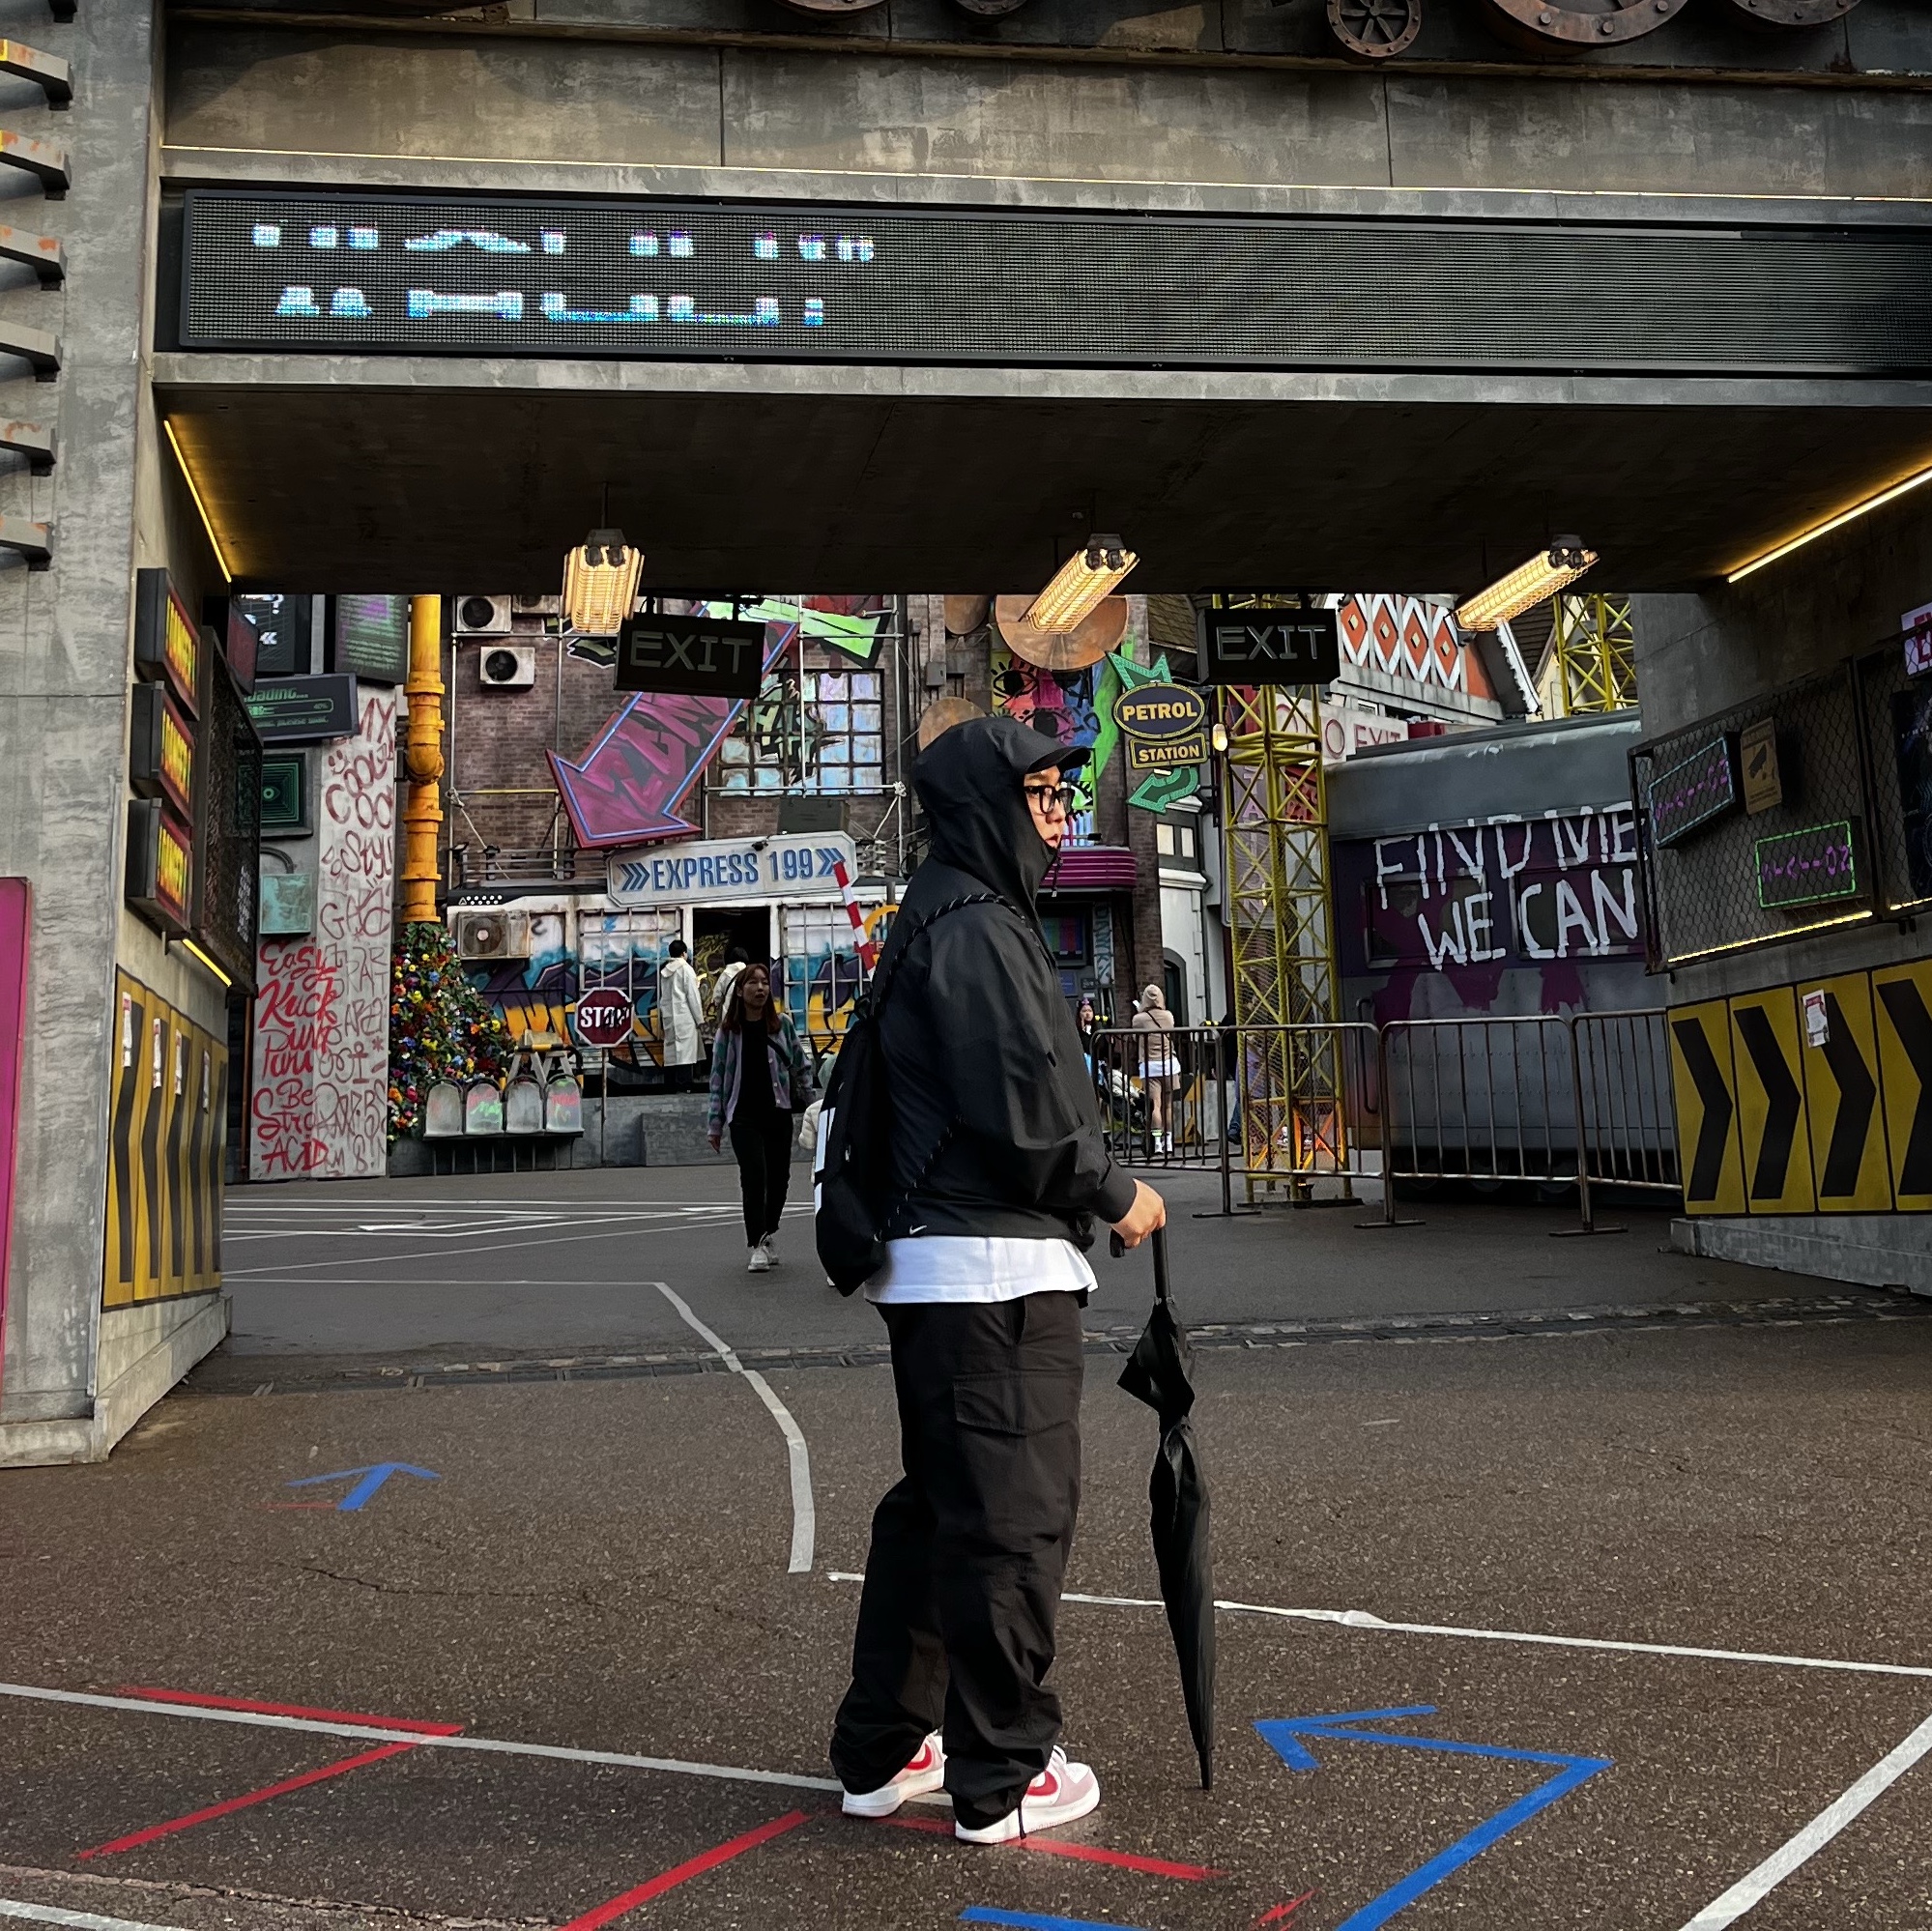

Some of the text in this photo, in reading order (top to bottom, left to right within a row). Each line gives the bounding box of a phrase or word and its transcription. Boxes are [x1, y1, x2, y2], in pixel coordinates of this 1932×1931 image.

[630, 630, 753, 675] EXIT
[1216, 624, 1327, 661] EXIT
[1122, 702, 1198, 722] PETROL
[1139, 744, 1200, 763] STATION
[651, 848, 814, 892] EXPRESS 199
[1374, 801, 1638, 909] FIND ME
[1418, 869, 1638, 970] WE CAN
